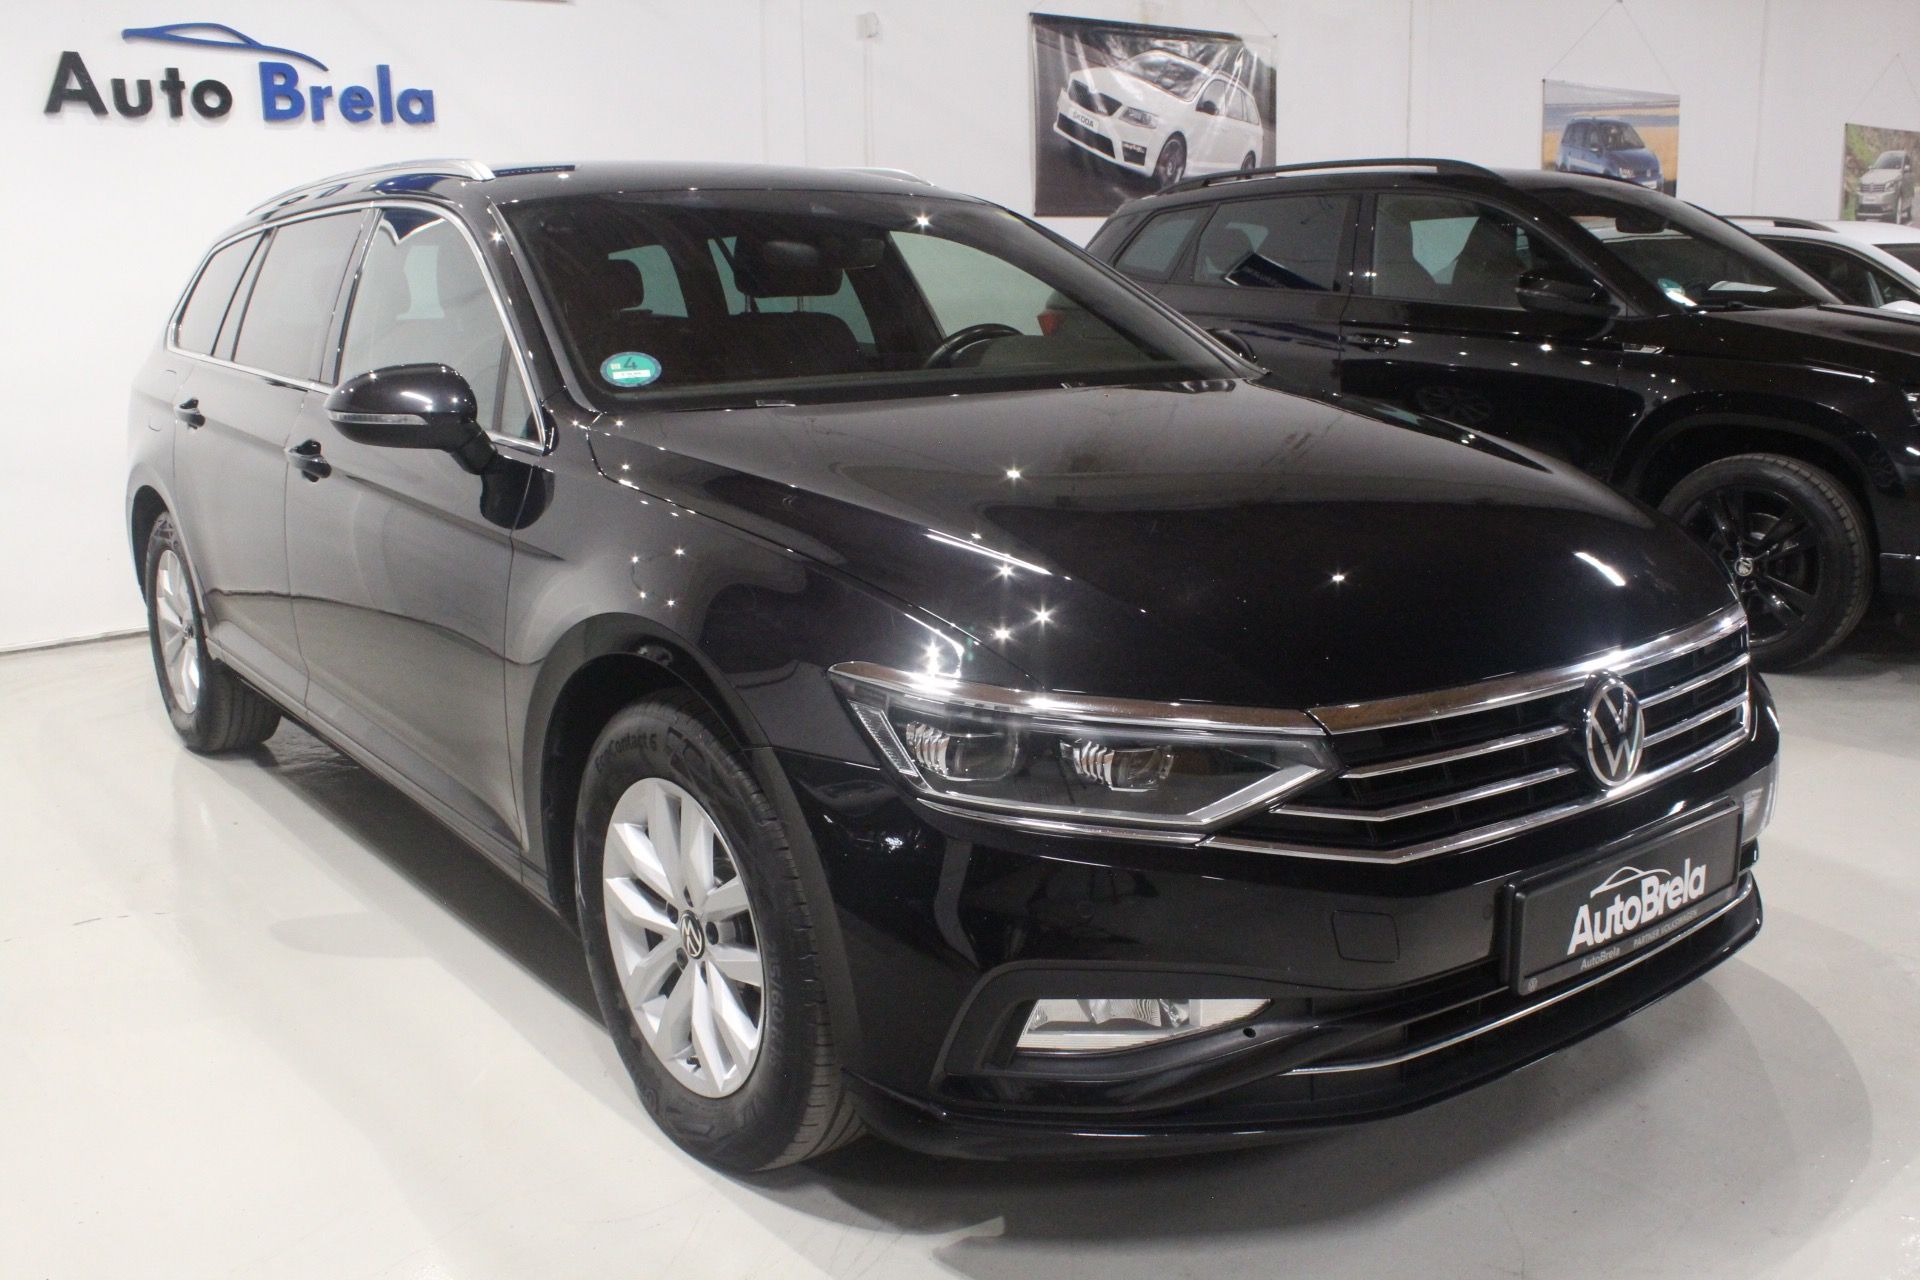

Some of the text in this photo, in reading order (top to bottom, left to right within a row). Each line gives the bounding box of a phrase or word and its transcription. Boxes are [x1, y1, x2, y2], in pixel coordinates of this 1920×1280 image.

[44, 51, 436, 125] Auto Brela
[623, 356, 638, 370] 4
[1567, 858, 1706, 956] AutoBrela
